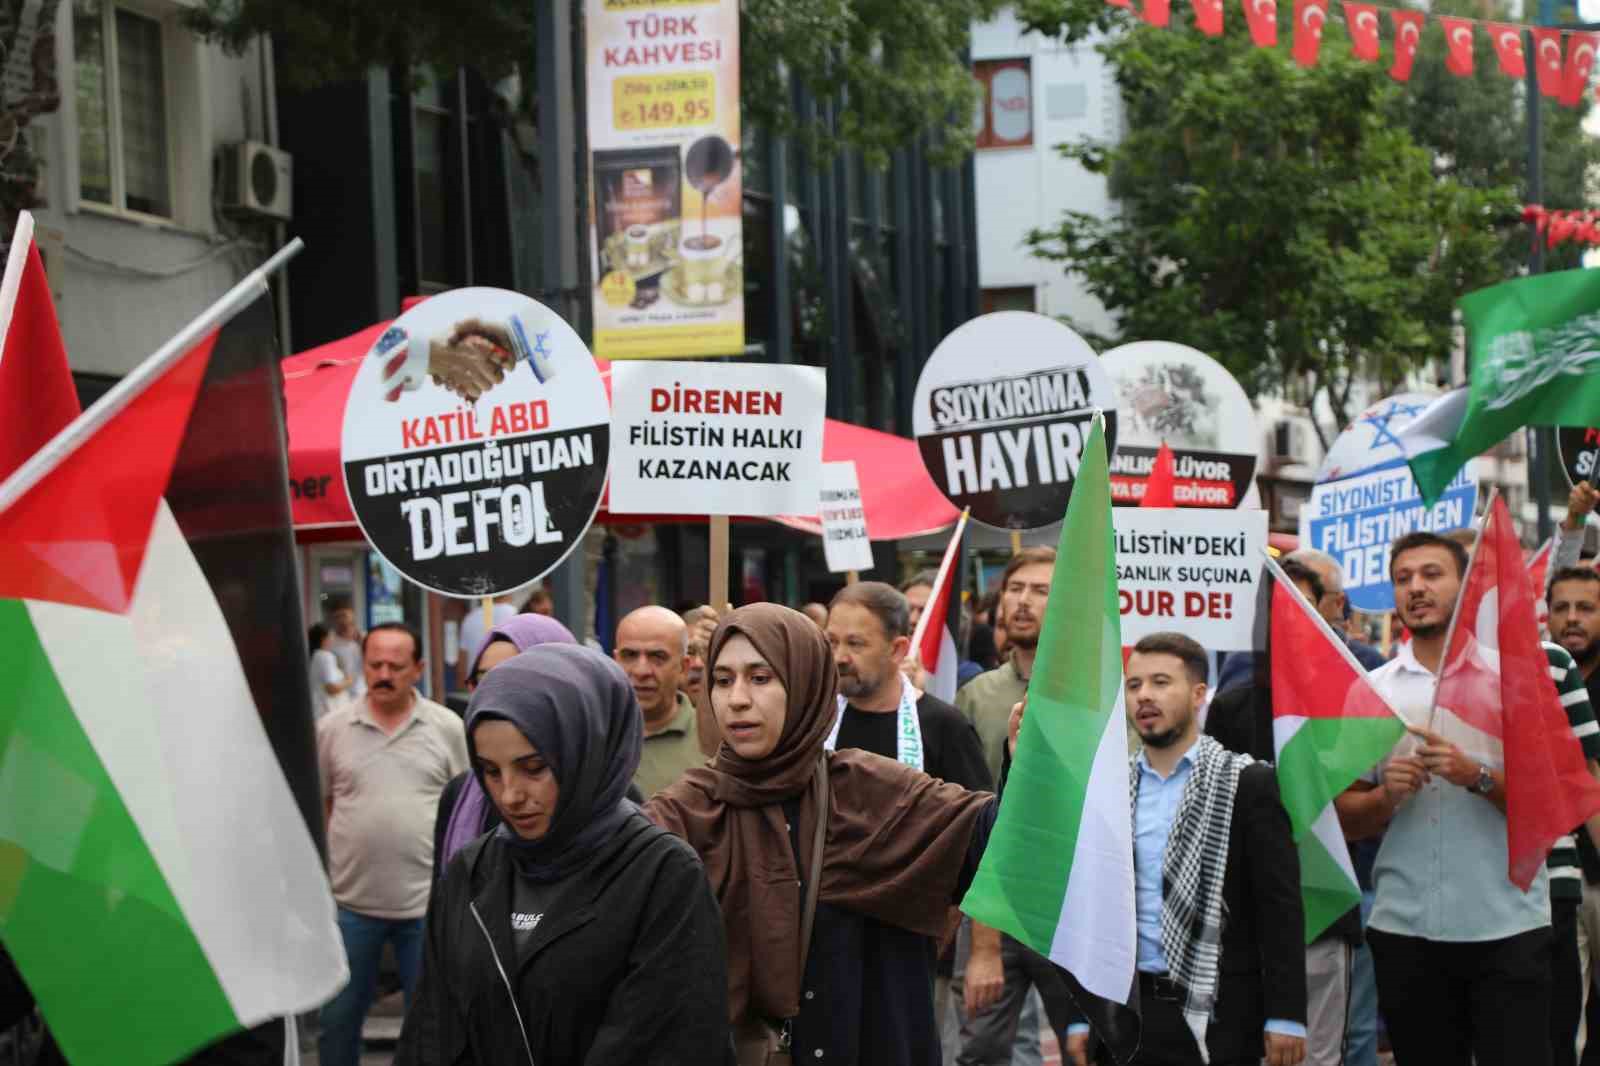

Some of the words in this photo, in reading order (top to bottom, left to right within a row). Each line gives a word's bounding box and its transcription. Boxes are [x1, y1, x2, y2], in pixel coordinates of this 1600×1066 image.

[625, 14, 697, 39] TÜRK
[604, 40, 722, 67] KAHVESİ
[650, 381, 783, 416] DİRENEN
[933, 371, 1087, 426] SOYKIRIMA
[401, 405, 483, 449] KATİL
[490, 400, 549, 436] ABD
[629, 420, 724, 447] FİLİSTİN
[732, 428, 802, 449] HALKI
[364, 433, 594, 497] ORTADOĞU'DAN
[638, 459, 792, 481] KAZANACAK
[1173, 455, 1231, 481] LÜYOR
[1320, 476, 1408, 516] SİYONİST
[401, 481, 563, 561] DEFOL
[1113, 529, 1246, 557] İLİSTİN'DEKİ
[1116, 565, 1173, 581] SANLIK
[1178, 566, 1253, 587] SUÇUNA
[1183, 591, 1233, 620] DE!
